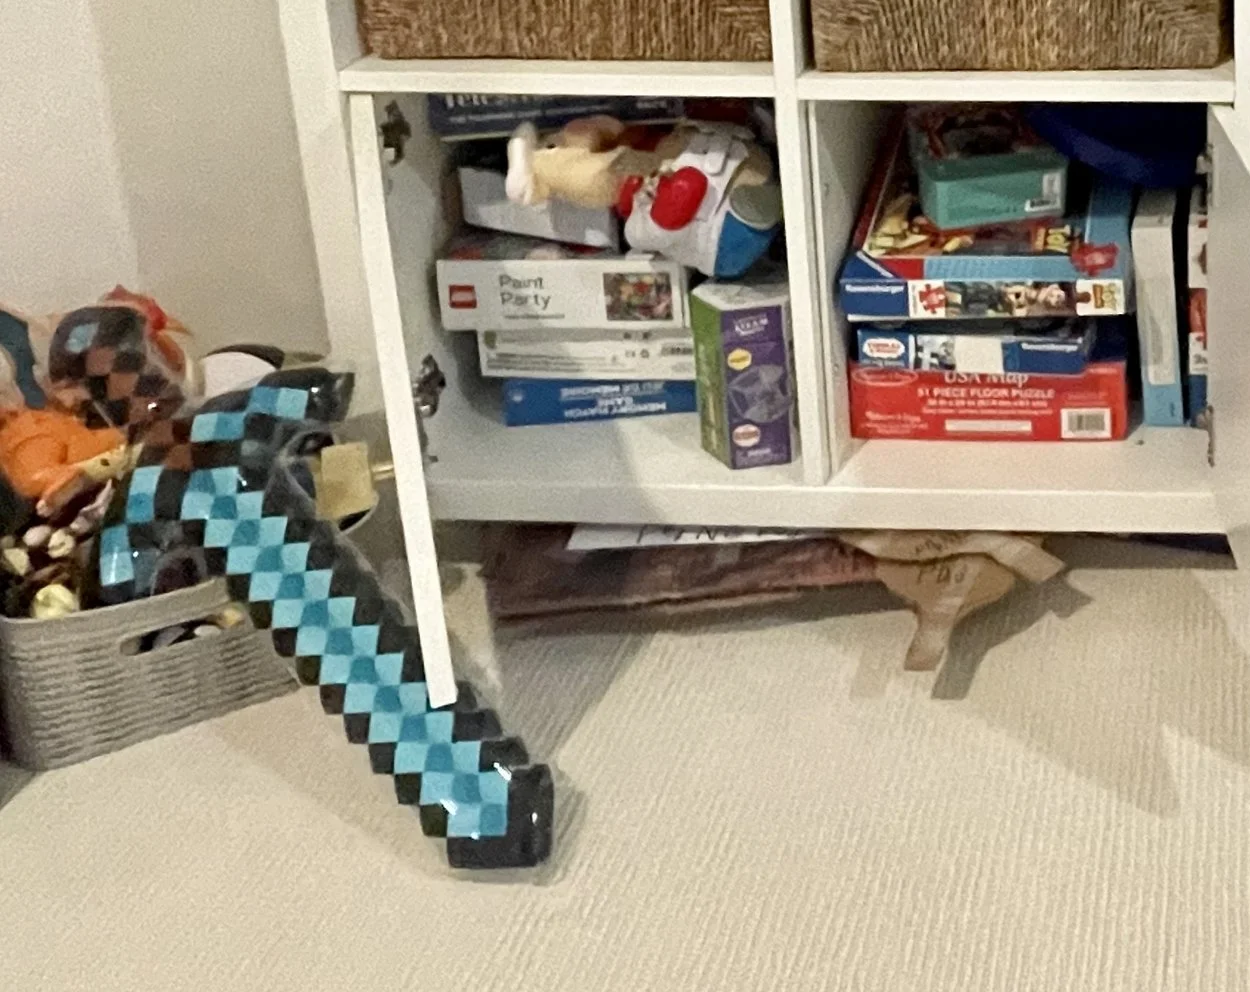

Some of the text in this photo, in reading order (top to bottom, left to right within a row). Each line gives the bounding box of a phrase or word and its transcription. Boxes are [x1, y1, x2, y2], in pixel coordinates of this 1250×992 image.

[500, 274, 544, 289] Paint
[501, 292, 551, 310] Party
[933, 388, 967, 398] PIECE
[970, 388, 1009, 398] FLOOR
[1011, 388, 1055, 398] PUZZLE
